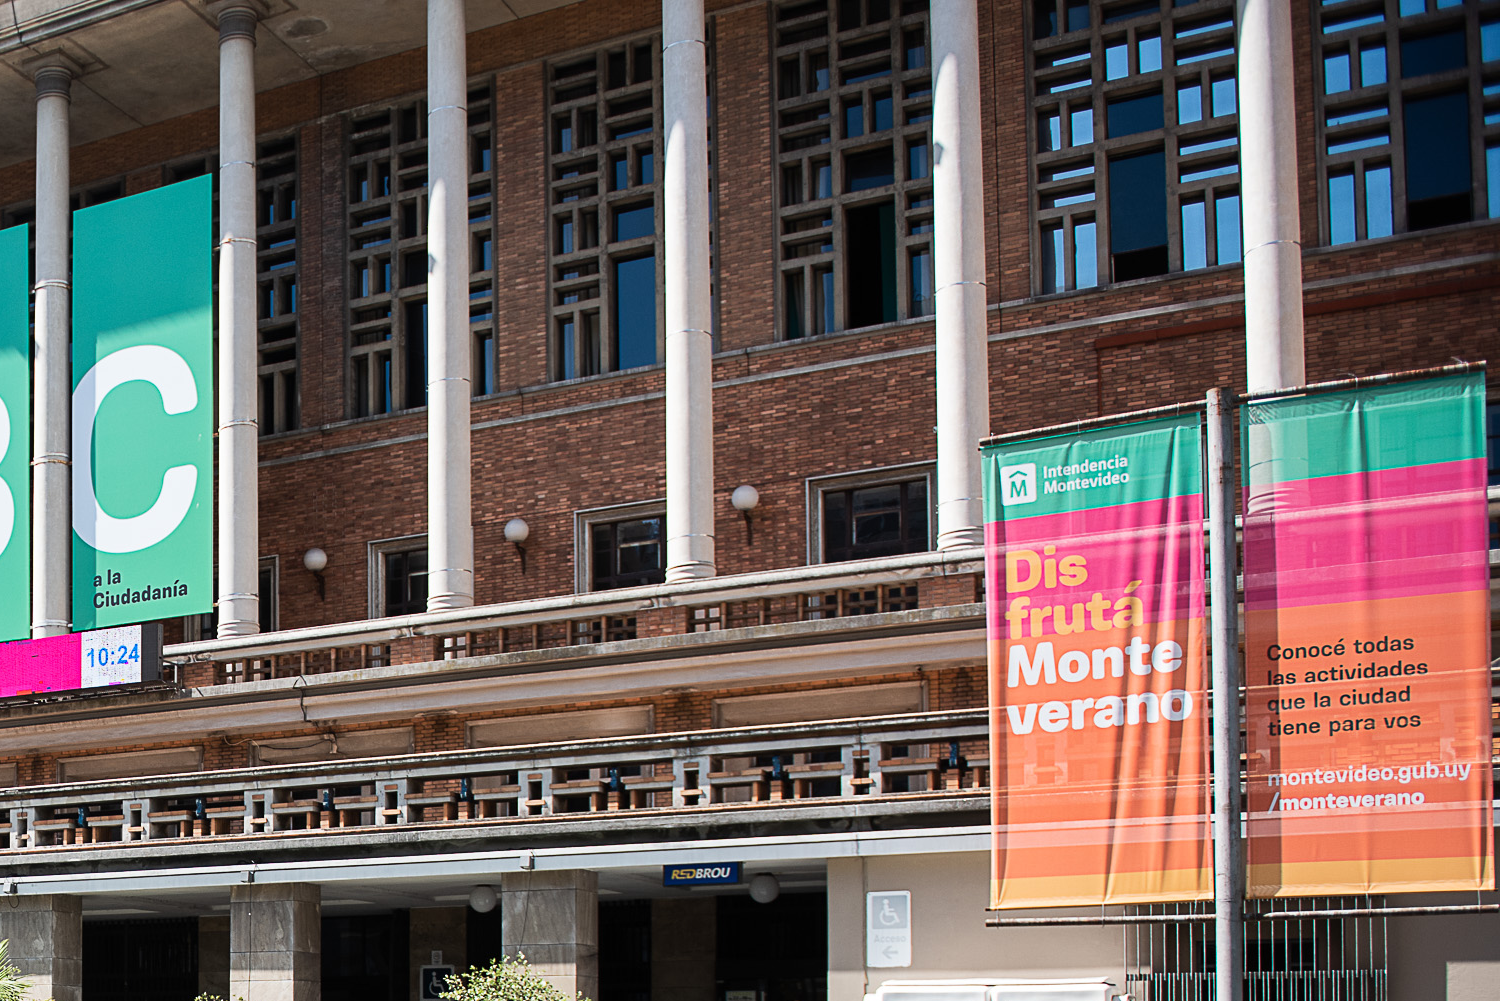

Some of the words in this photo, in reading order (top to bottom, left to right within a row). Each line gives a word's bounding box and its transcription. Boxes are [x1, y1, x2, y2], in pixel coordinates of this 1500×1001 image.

[72, 344, 199, 555] C
[1043, 456, 1128, 479] Intendencia
[1043, 471, 1129, 494] Montevideo
[93, 575, 102, 587] a
[108, 569, 121, 585] la
[1006, 544, 1088, 593] Dis
[93, 580, 188, 608] Ciudadanía
[1005, 579, 1144, 640] frutá
[87, 644, 140, 668] 10:24
[1007, 635, 1183, 688] Monte
[1267, 638, 1345, 661] Conocé
[1353, 636, 1414, 654] todas
[1268, 670, 1296, 686] las
[1304, 660, 1428, 684] actividades
[1006, 688, 1193, 735] verano
[1268, 697, 1305, 714] que
[1314, 692, 1331, 708] la
[1340, 686, 1411, 706] ciudad
[1268, 719, 1320, 736] tiene
[1329, 717, 1375, 736] para
[1384, 714, 1421, 729] vos
[1268, 761, 1471, 787] montevideo.gub.uy
[1268, 791, 1424, 814] /monteverano
[874, 935, 906, 943] Acceso
